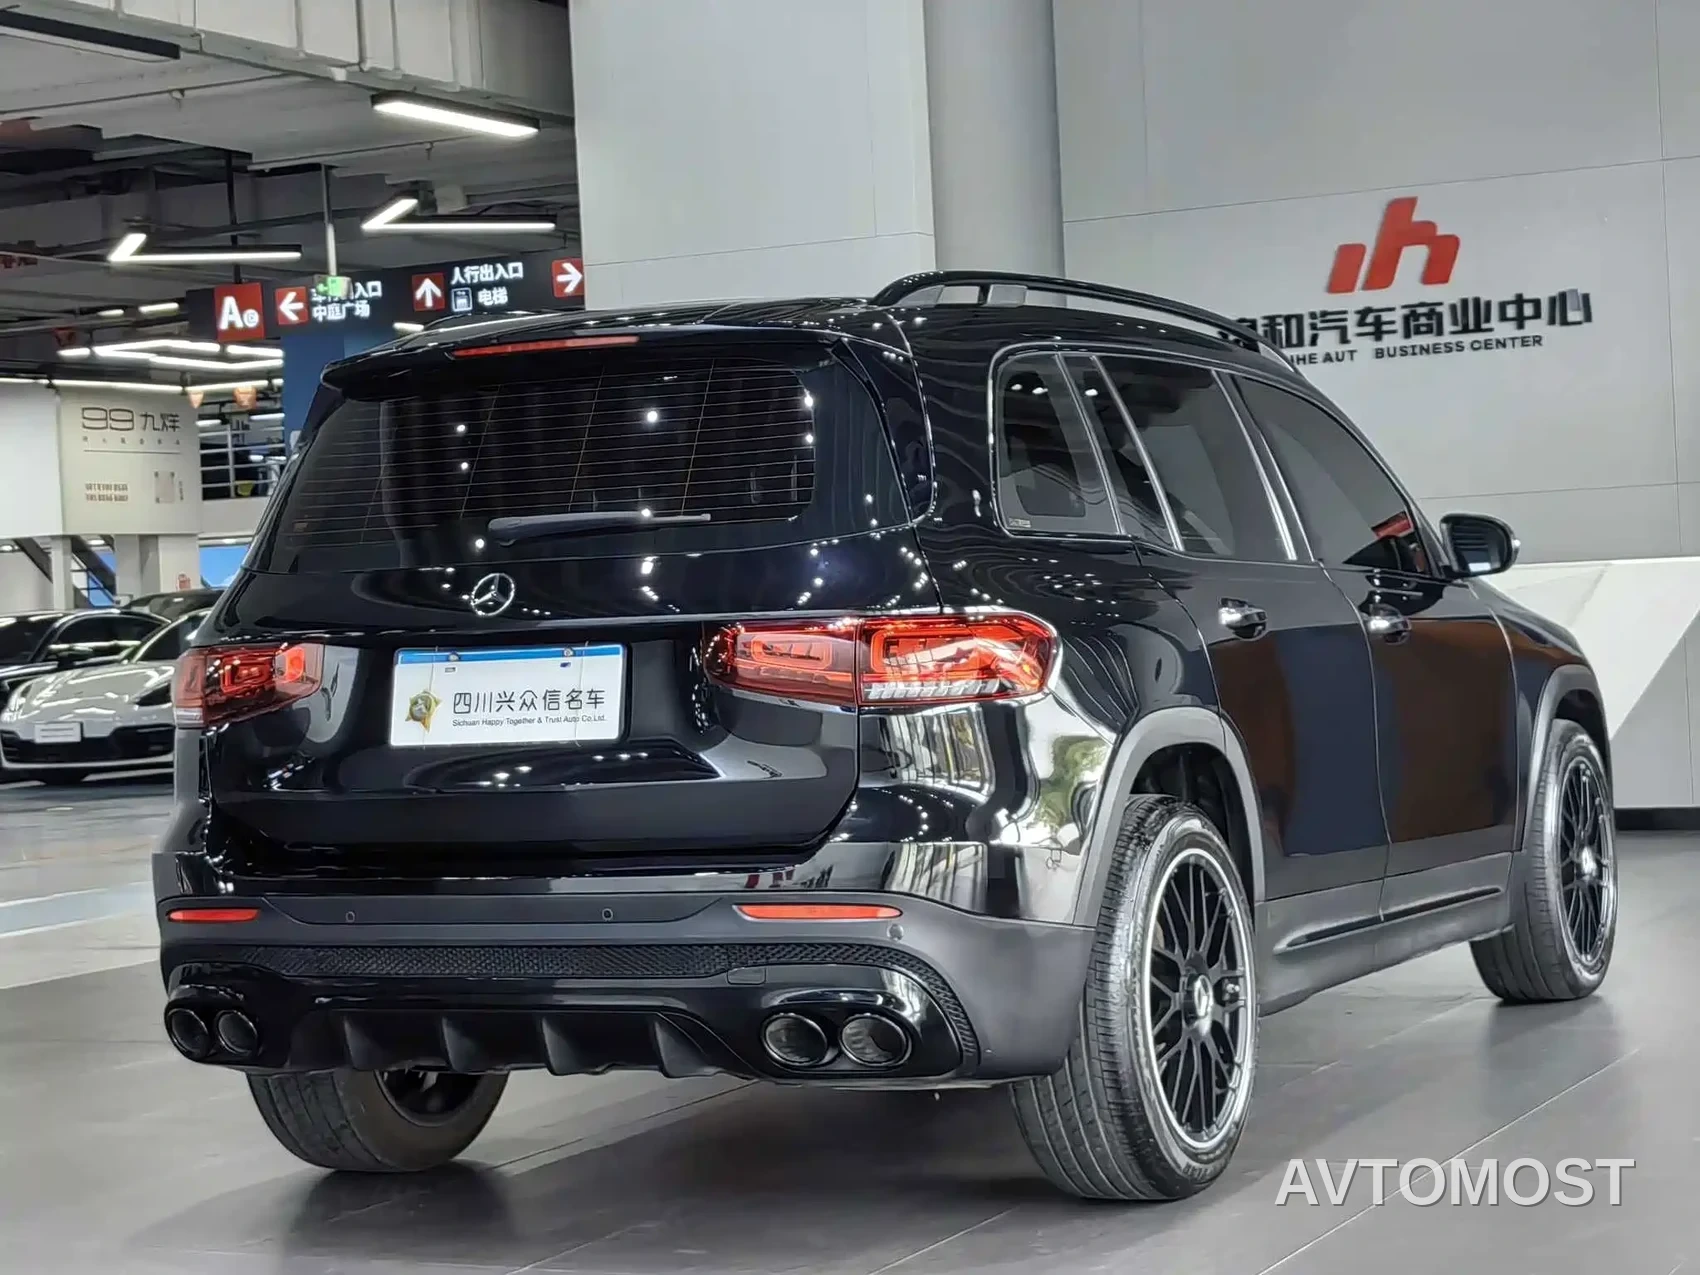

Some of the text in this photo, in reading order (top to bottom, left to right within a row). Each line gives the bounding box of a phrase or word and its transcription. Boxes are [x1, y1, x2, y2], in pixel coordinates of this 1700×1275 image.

[451, 262, 524, 284] 人行出入口
[477, 287, 508, 306] 电梯
[312, 299, 370, 322] 中庭广场
[1374, 340, 1465, 359] BUSINESS
[1470, 335, 1543, 351] CENTER
[82, 407, 134, 431] 99
[453, 689, 605, 714] 四川兴众信名车
[453, 719, 480, 727] Sichuan
[481, 718, 503, 727] Happy
[506, 717, 535, 726] Together
